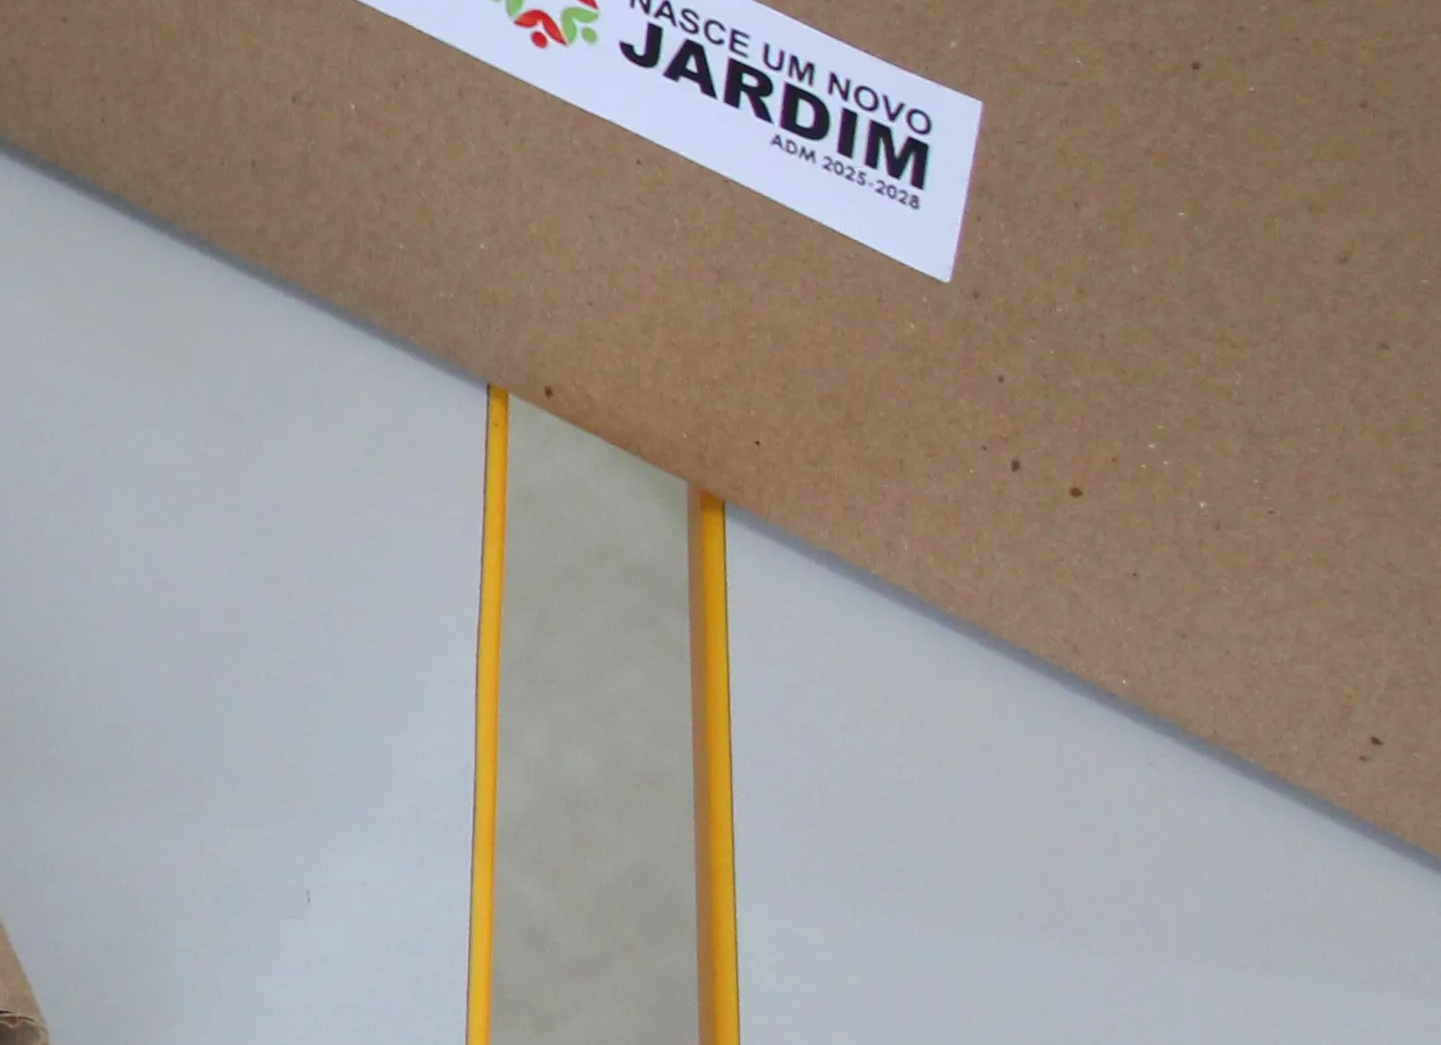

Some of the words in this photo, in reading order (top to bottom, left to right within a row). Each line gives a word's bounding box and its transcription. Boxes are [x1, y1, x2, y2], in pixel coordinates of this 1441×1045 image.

[618, 22, 930, 191] JARDIM
[763, 43, 815, 86] UM
[828, 72, 932, 136] NOVO
[770, 134, 817, 165] ADM
[822, 155, 921, 210] 2025-2028
